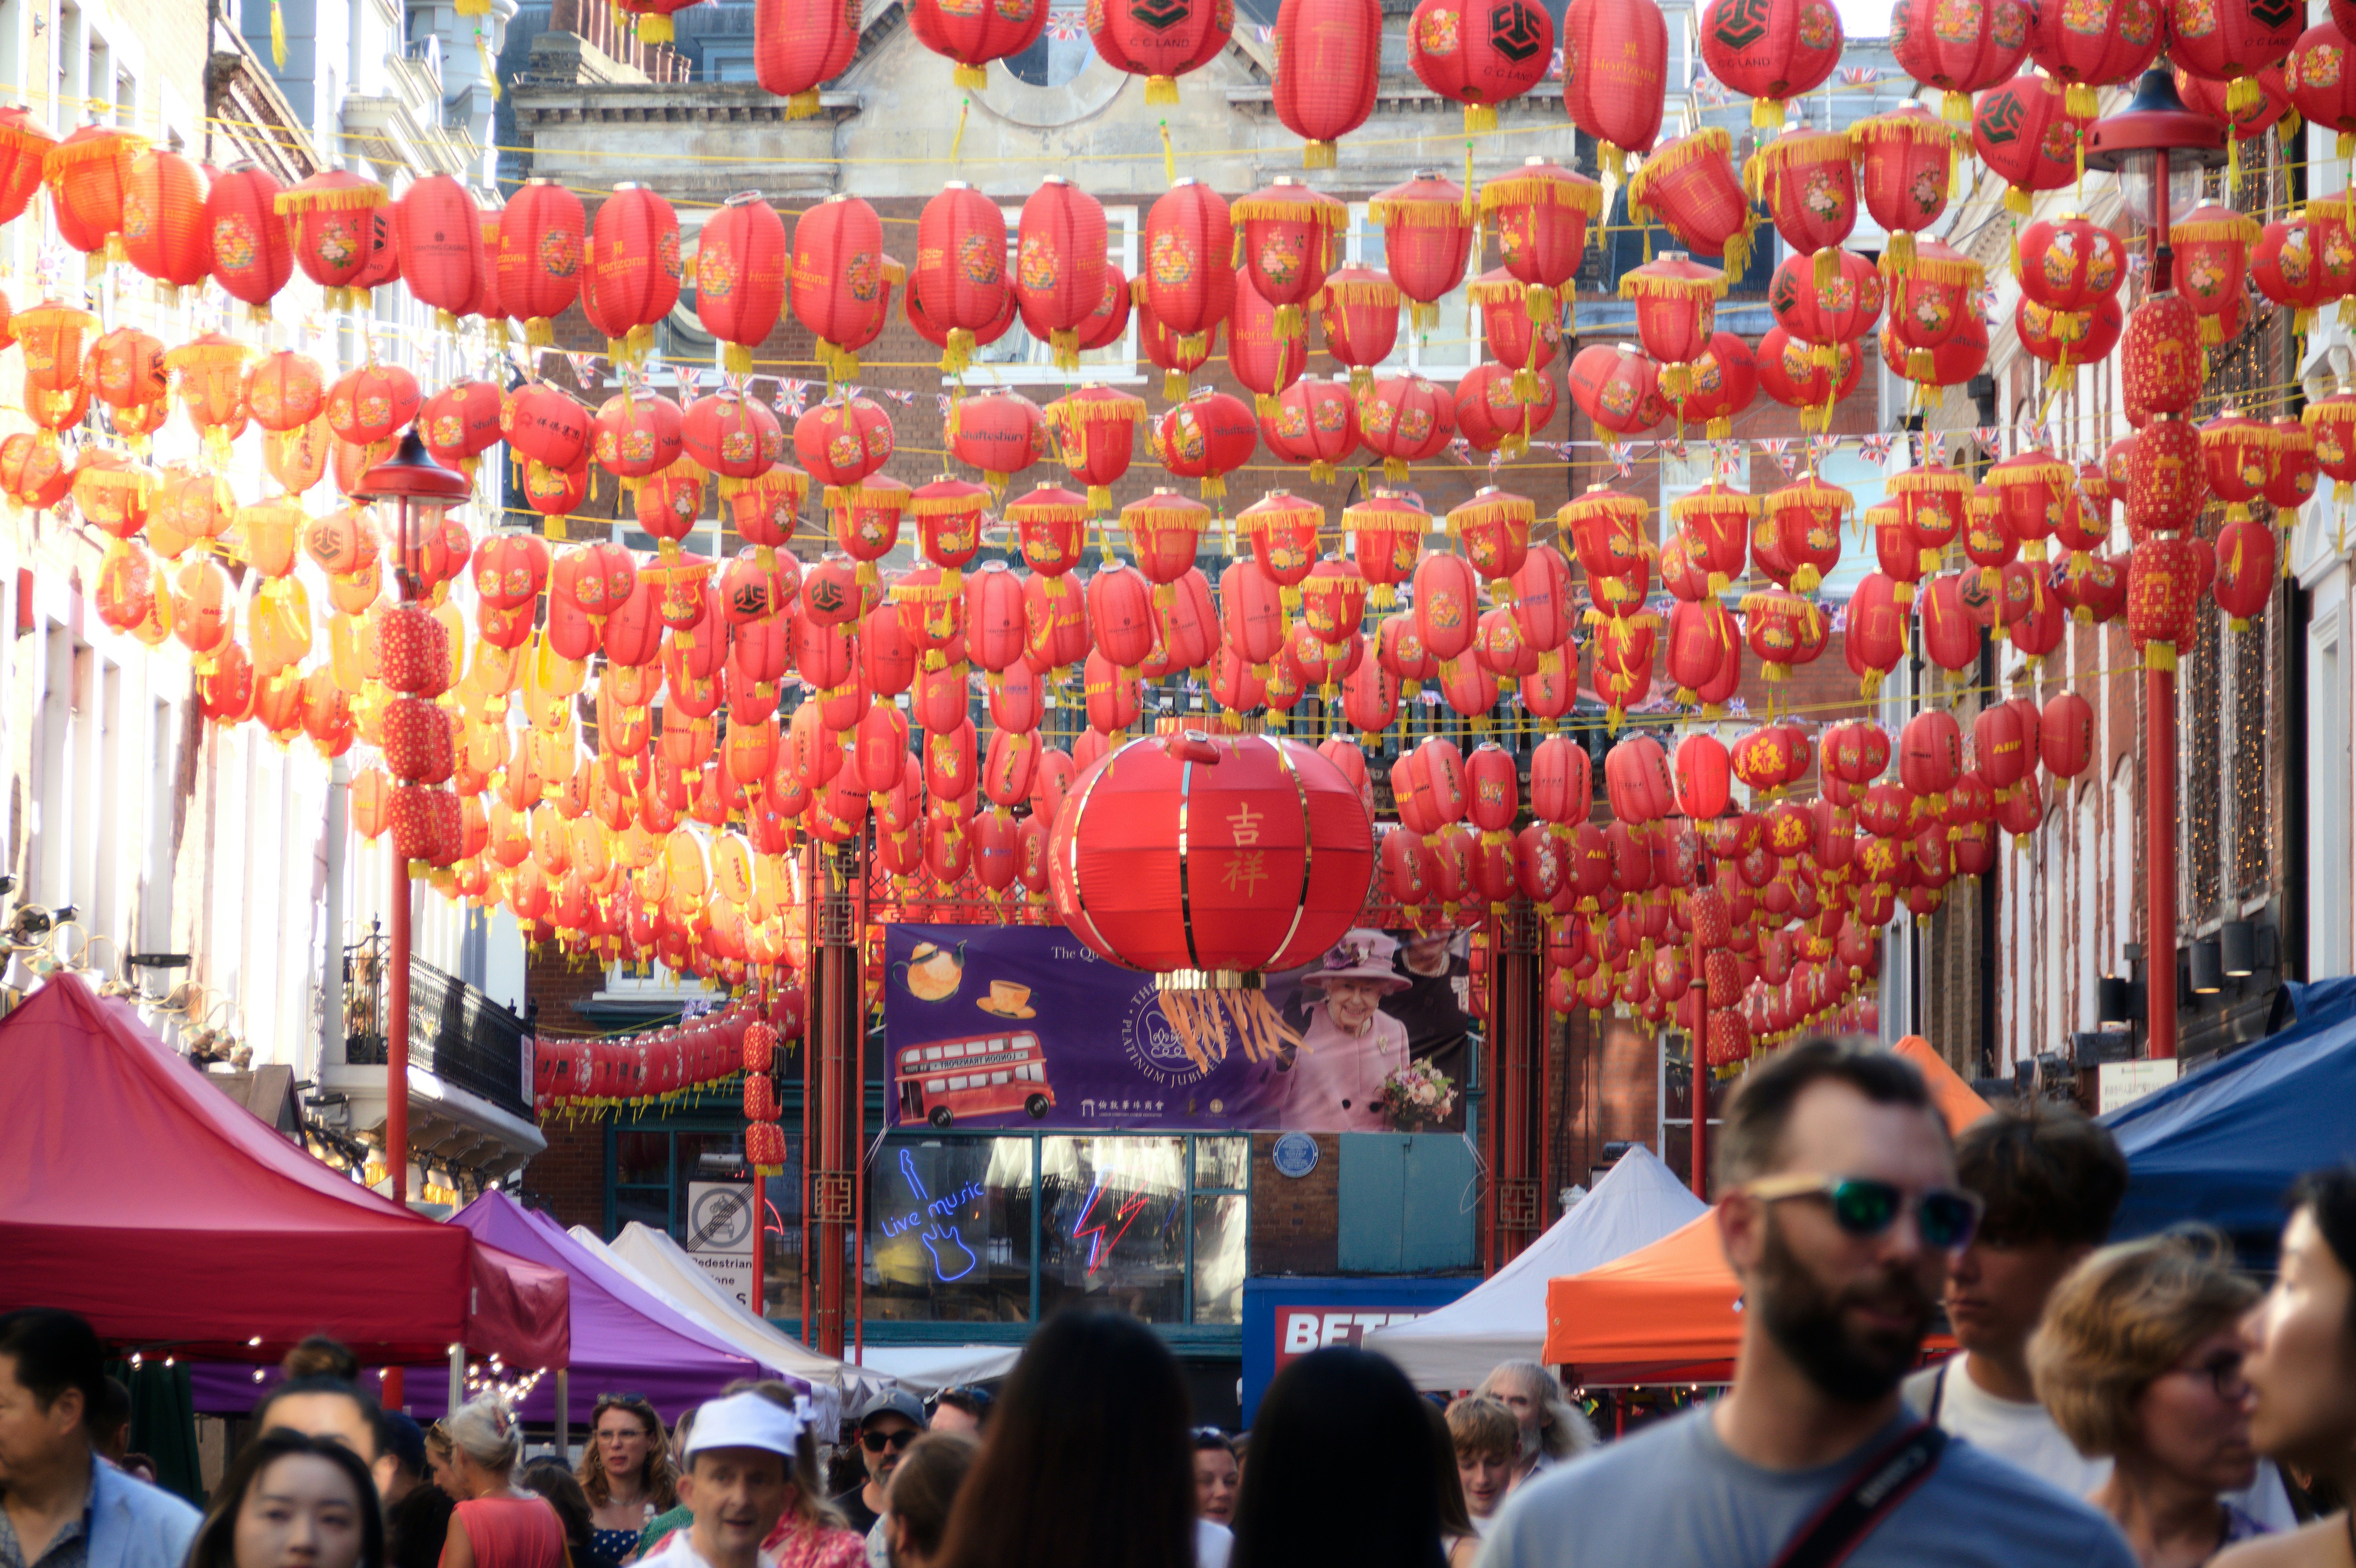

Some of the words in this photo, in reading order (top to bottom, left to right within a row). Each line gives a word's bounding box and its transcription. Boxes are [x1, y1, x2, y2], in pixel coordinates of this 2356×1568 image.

[1593, 58, 1657, 83] Horizons
[597, 256, 647, 275] Horizons
[959, 429, 1026, 445] Shaftesbury
[1221, 801, 1269, 899] 吉祥
[1051, 946, 1076, 959] The
[1122, 1019, 1165, 1084] PLATINUM
[928, 1180, 984, 1218] music
[711, 1274, 735, 1286] one
[1284, 1313, 1429, 1354] BET
